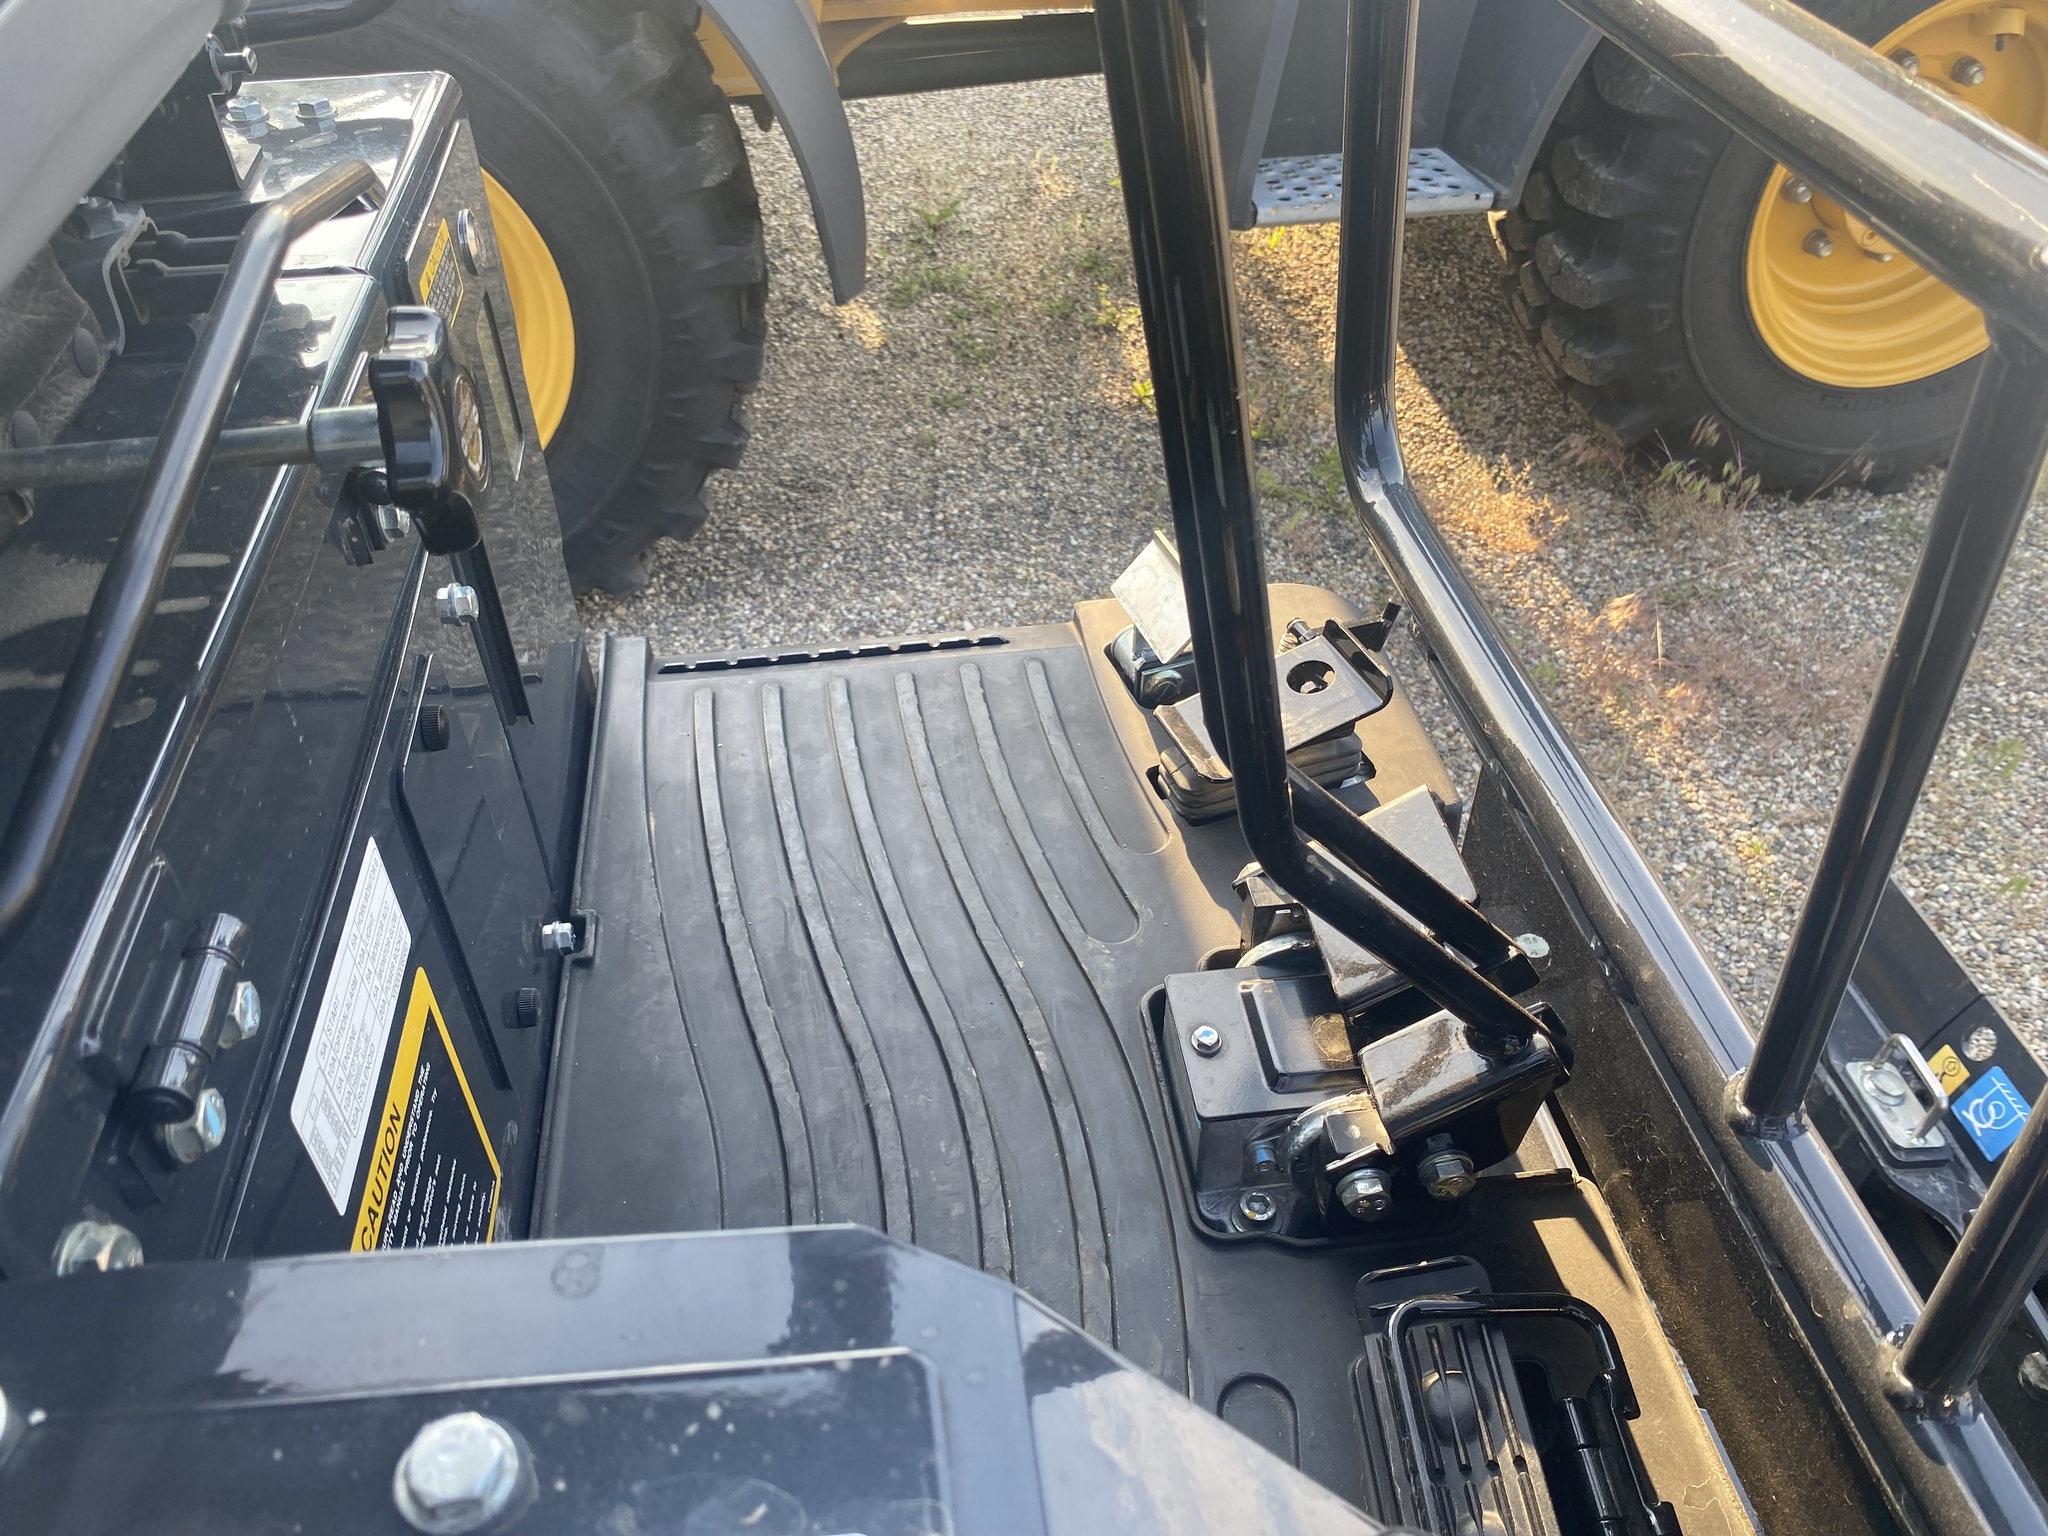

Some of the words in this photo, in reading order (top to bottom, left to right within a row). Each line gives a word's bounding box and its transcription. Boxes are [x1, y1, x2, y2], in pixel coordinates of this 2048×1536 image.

[352, 934, 358, 950] 5A
[365, 913, 375, 946] LIGHT
[372, 921, 384, 962] MONITOR
[379, 938, 391, 979] MONITOR
[389, 911, 398, 939] GLOW
[358, 949, 366, 968] 10A
[366, 969, 373, 984] 5A
[386, 962, 395, 995] POWER
[394, 928, 403, 963] SOCKET
[373, 986, 379, 1001] 5A
[327, 995, 340, 1036] START
[321, 1042, 328, 1060] 5A
[343, 1026, 357, 1071] ENGINE
[328, 1057, 337, 1078] 10A
[337, 1077, 344, 1094] 5A
[358, 1044, 375, 1103] SOLENOID
[344, 1091, 352, 1112] 10A
[392, 1181, 406, 1226] MANUAL
[404, 1140, 414, 1176] PRIOR
[412, 1122, 418, 1137] TO
[416, 1061, 431, 1120] OPERATING
[395, 1162, 404, 1188] AND
[402, 1088, 420, 1160] UNDERSTAND
[361, 1101, 402, 1252] CAUTION
[410, 1163, 421, 1206] operator
[423, 1176, 432, 1212] engage
[452, 1204, 461, 1240] moving
